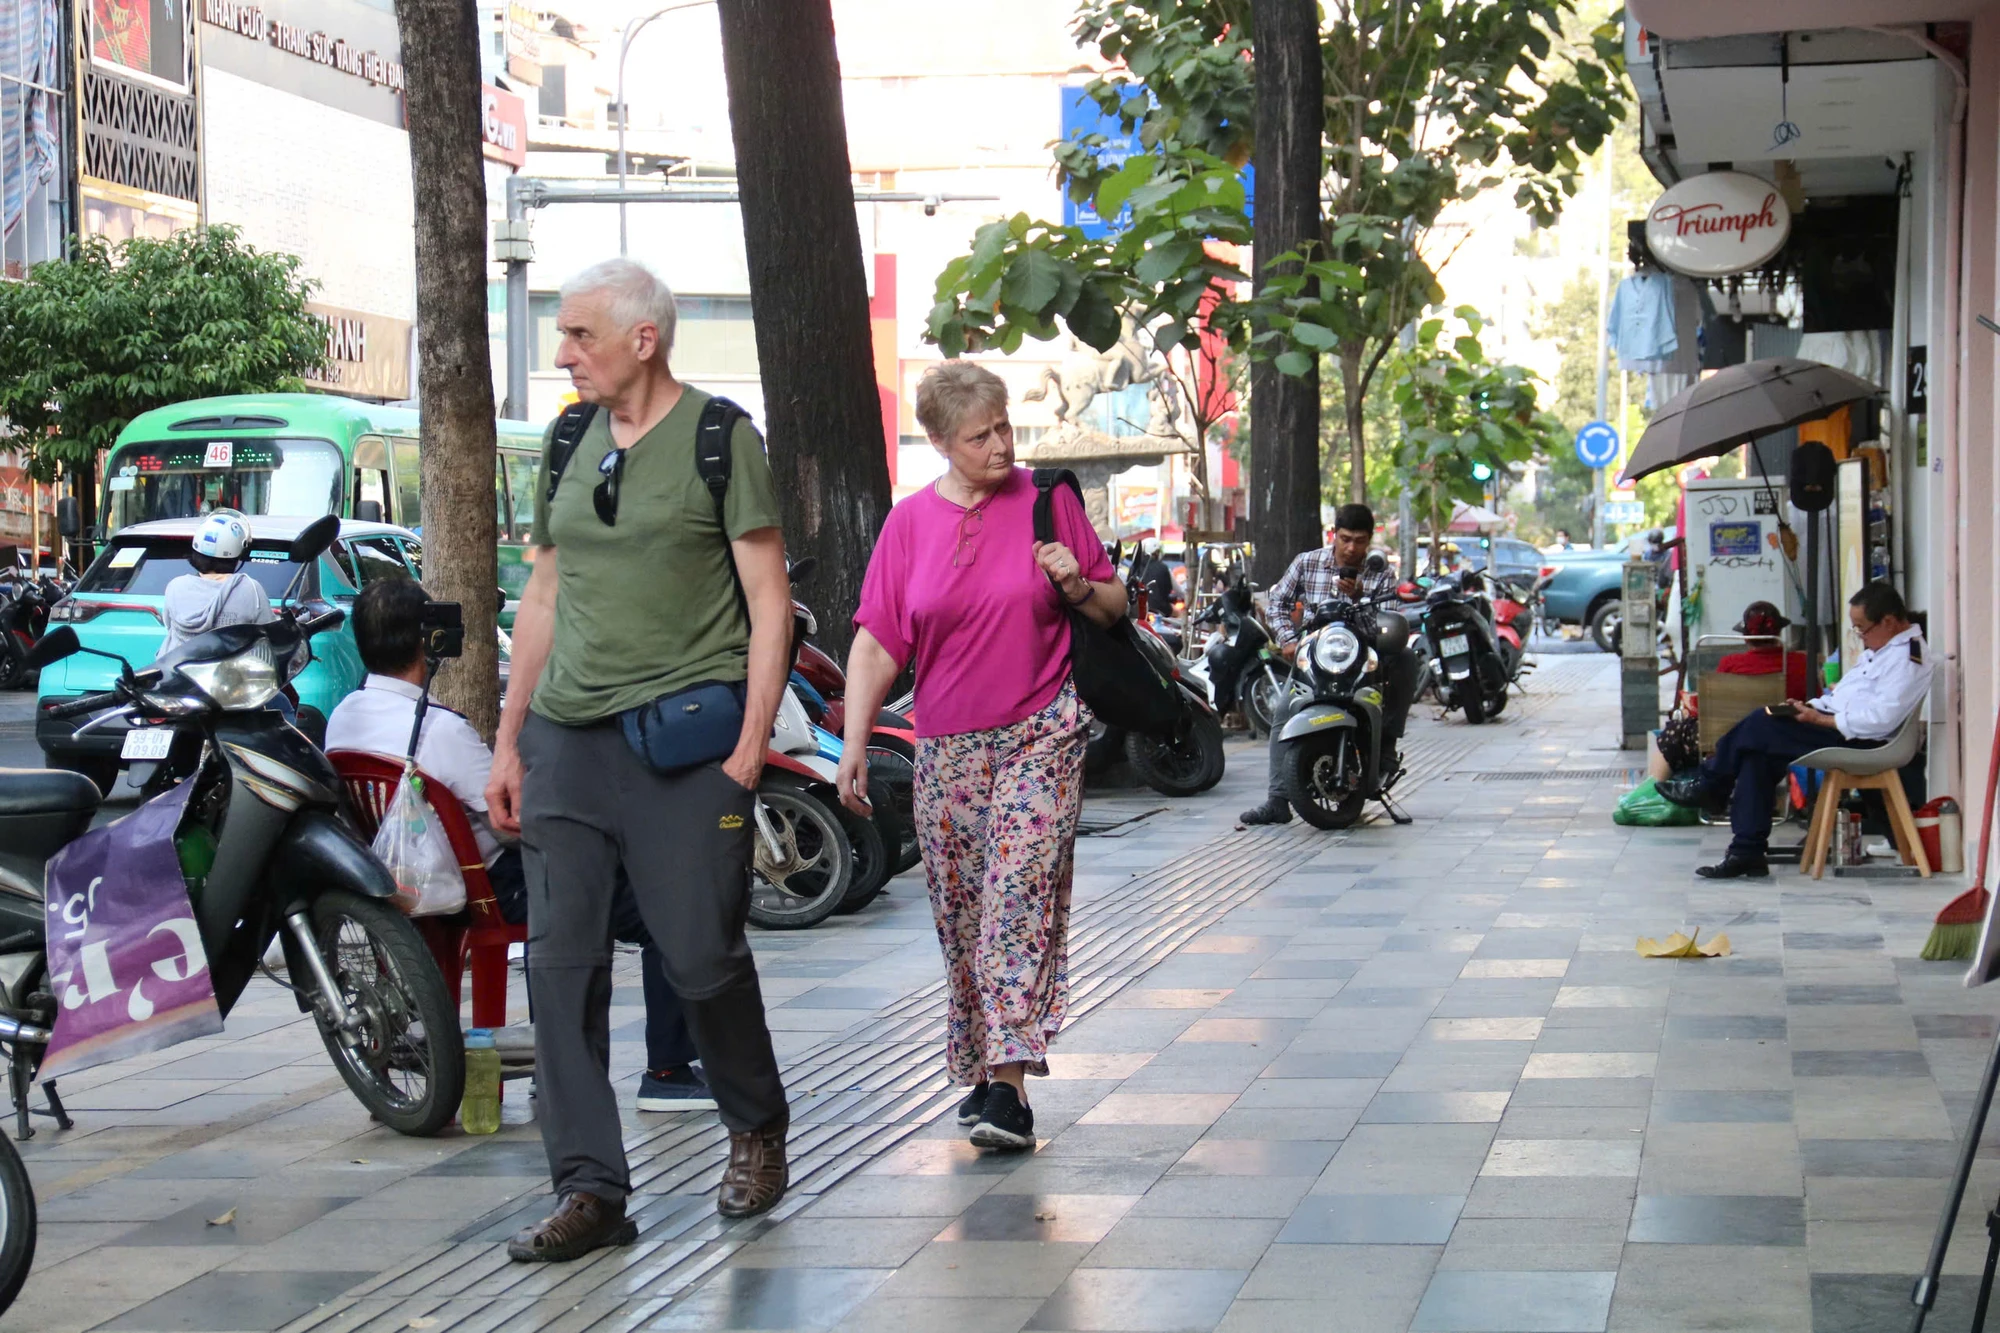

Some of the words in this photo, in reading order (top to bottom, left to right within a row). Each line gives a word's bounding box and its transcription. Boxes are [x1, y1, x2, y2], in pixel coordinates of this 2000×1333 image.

[482, 94, 516, 151] G.vn
[1653, 192, 1780, 243] Triumph
[210, 446, 229, 461] 46
